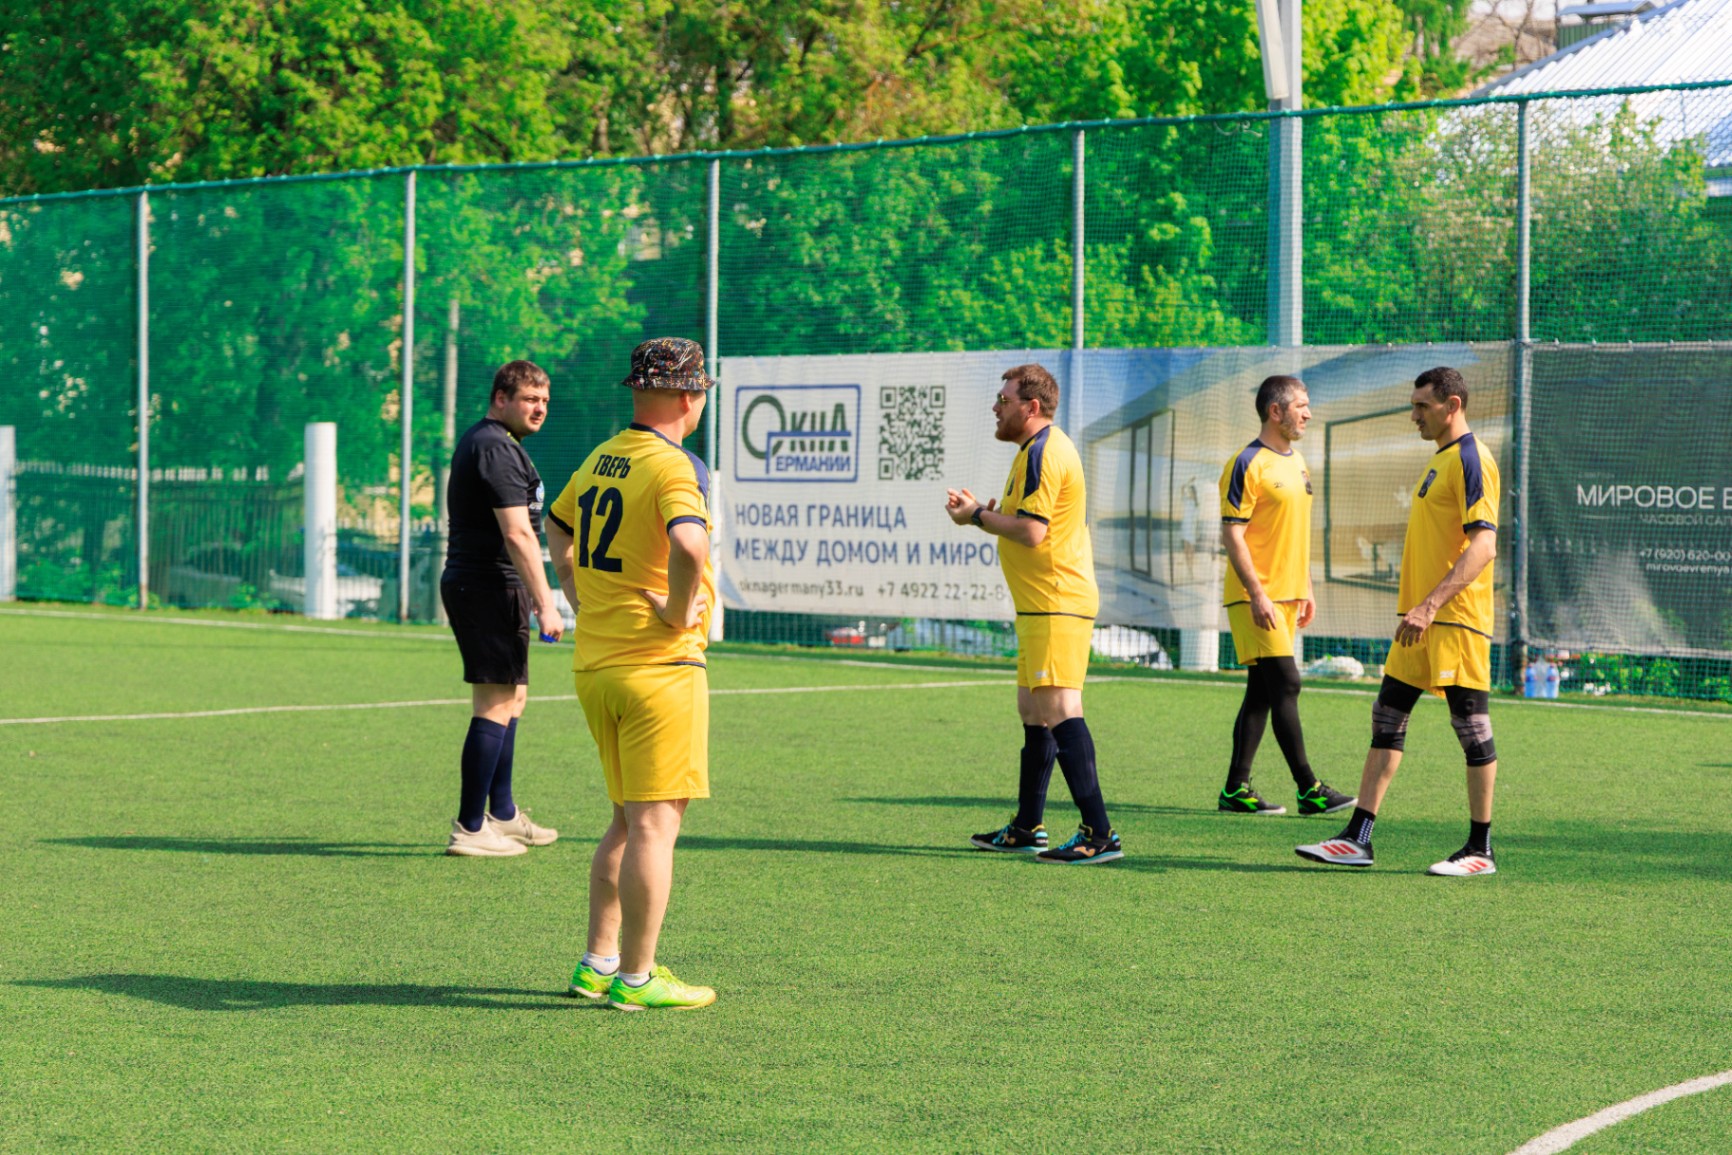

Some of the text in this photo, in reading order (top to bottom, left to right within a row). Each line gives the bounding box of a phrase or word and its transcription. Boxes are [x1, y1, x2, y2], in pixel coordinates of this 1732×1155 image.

[1577, 484, 1715, 510] МИРОВОЕ
[578, 485, 623, 572] 12
[735, 503, 906, 532] НОВАЯ ГРАНИЦА
[735, 538, 999, 567] МЕЖДУ ДОМОМ И МИРО
[1688, 549, 1732, 561] 620-00
[1646, 563, 1732, 577] mirovoevremya
[878, 582, 895, 597] +7
[900, 582, 939, 599] 4922
